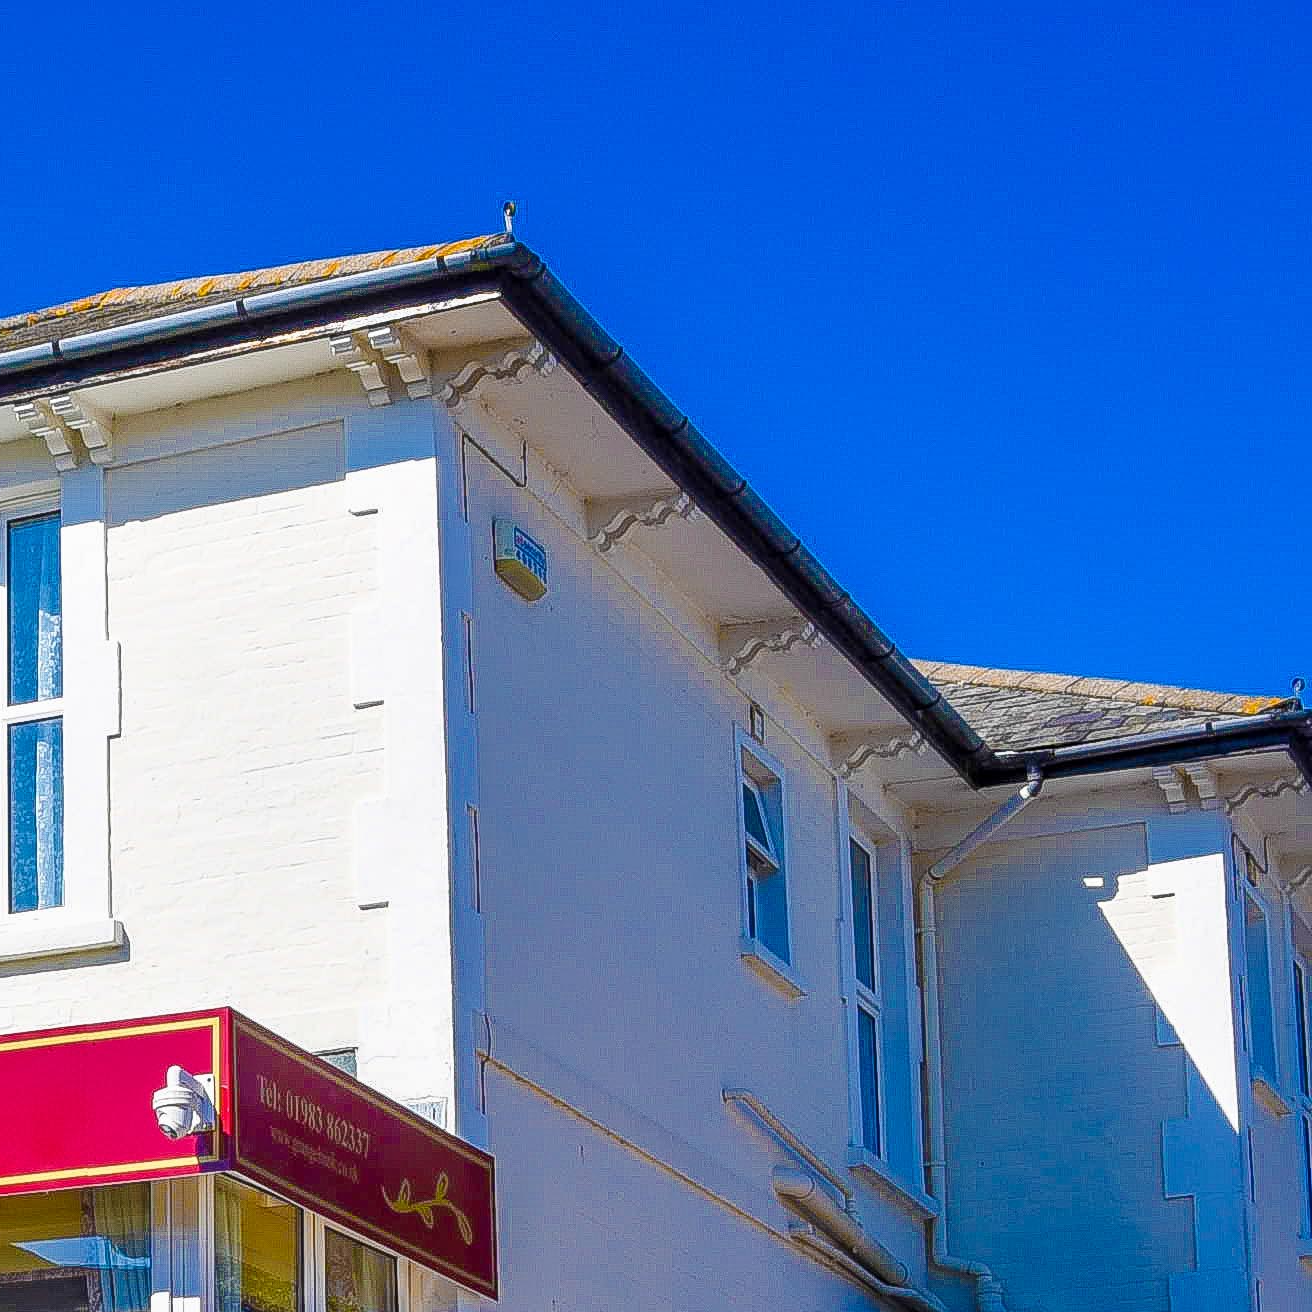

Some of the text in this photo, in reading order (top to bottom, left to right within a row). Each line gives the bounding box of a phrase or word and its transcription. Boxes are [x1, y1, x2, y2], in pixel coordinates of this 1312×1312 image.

[256, 1074, 281, 1112] Tel:
[286, 1089, 323, 1134] 01983
[326, 1112, 369, 1160] 862337
